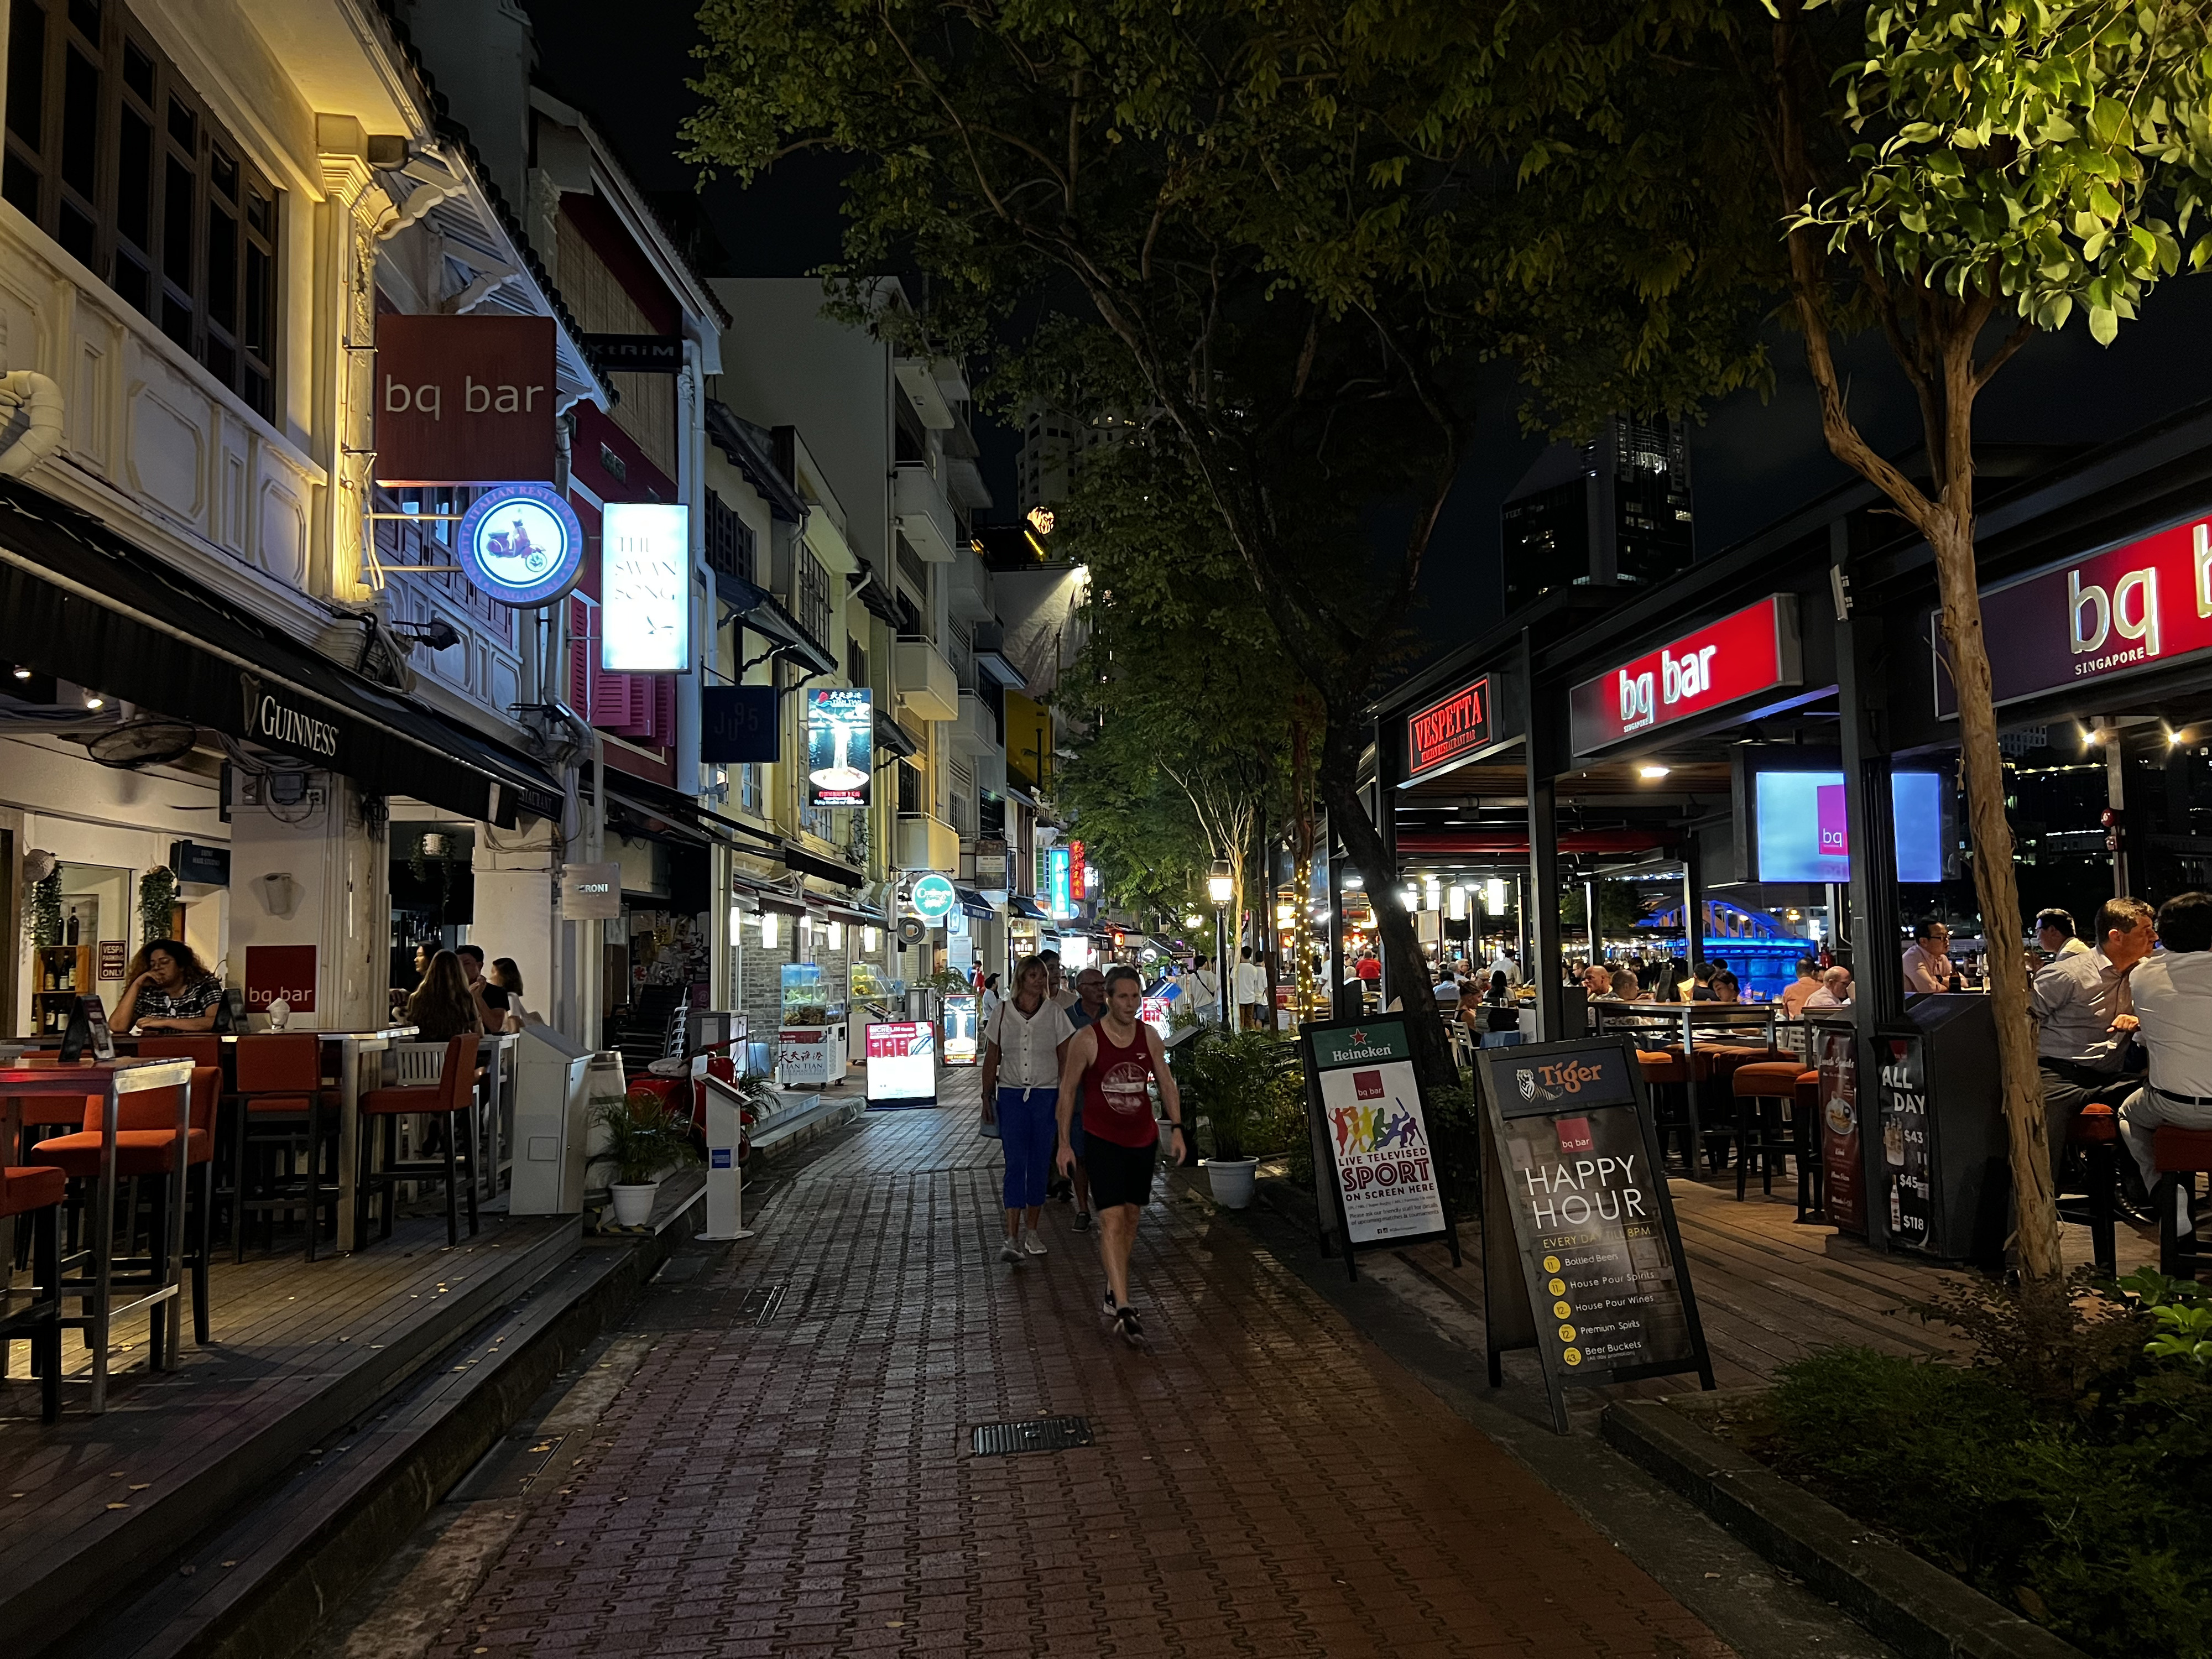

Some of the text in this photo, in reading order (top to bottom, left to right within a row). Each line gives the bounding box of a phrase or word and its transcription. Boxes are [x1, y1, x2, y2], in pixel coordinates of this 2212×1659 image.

[385, 374, 544, 421] bq bar
[469, 487, 515, 521] ITALIAN
[519, 486, 579, 541] RESTAURANT
[564, 546, 580, 572] BAR
[491, 578, 562, 600] SINGAPORE
[2068, 567, 2159, 656] bq
[2075, 646, 2145, 675] SINGAPORE
[1619, 645, 1717, 724] bq bar
[261, 695, 339, 757] GUINNESS
[1414, 691, 1483, 752] VESPETTA
[1623, 718, 1650, 733] SINGAPORE
[1421, 729, 1476, 763] ITALIAN RESTAURANT BAR
[1823, 828, 1843, 848] bq
[102, 946, 123, 954] VESPA
[249, 986, 312, 1005] bq bar
[1333, 1045, 1392, 1062] Heineken
[1538, 1060, 1602, 1093] Tiger
[1881, 1065, 1913, 1089] ALL
[1893, 1092, 1926, 1115] DAY
[1562, 1138, 1590, 1149] bq bar
[1904, 1129, 1923, 1144] $43
[1338, 1147, 1427, 1166] LIVE TELEVISED
[1342, 1157, 1430, 1192] SPORT
[1525, 1155, 1635, 1196] HAPPY
[1900, 1173, 1919, 1189] $45
[1365, 1187, 1405, 1199] SCREEN
[1408, 1183, 1435, 1193] HERE
[1358, 1217, 1382, 1225] upcoming
[1408, 1209, 1439, 1218] tournaments
[1532, 1188, 1646, 1229] HOUR
[1903, 1214, 1924, 1231] $118
[1542, 1227, 1651, 1249] EVERY DAY TILL 8PM
[1564, 1253, 1619, 1266] Bottled Beers
[1569, 1271, 1655, 1289] House Pour Spirits
[1556, 1306, 1565, 1315] 12
[1575, 1295, 1654, 1312] House Pour Wines
[1561, 1330, 1570, 1339] 12
[1580, 1319, 1640, 1335] Premium Spirits
[1584, 1340, 1642, 1355] Beer Buckets
[1607, 1350, 1635, 1359] promotion)
[1566, 1354, 1577, 1362] 43
